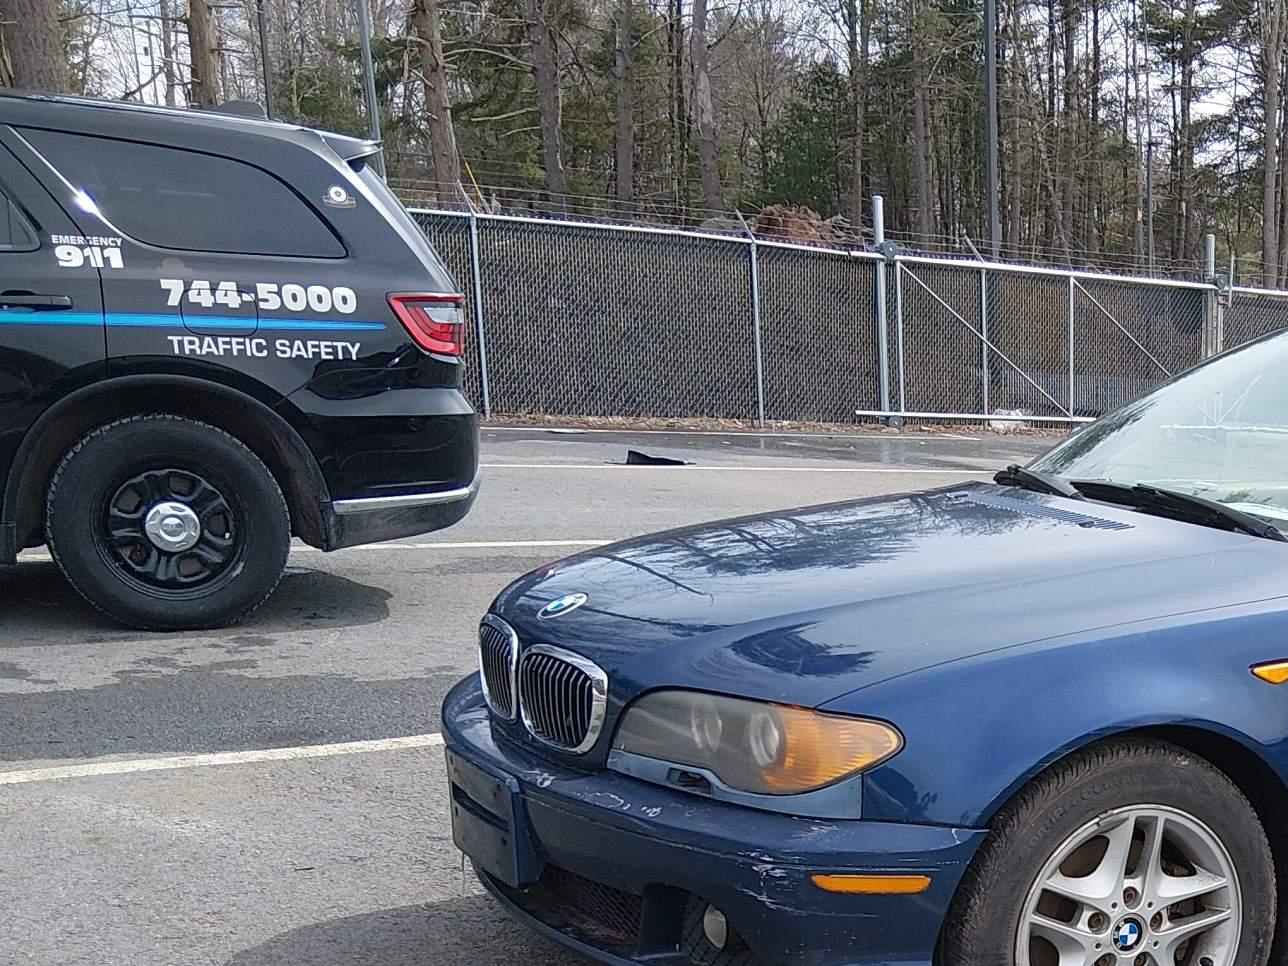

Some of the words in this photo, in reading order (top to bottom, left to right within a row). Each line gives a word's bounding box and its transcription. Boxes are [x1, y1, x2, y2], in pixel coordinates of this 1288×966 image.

[51, 234, 122, 247] EMERGENCY
[54, 245, 125, 269] 911
[159, 278, 357, 314] 744-5000
[167, 335, 268, 357] TRAFFIC
[275, 339, 361, 361] SAFETY
